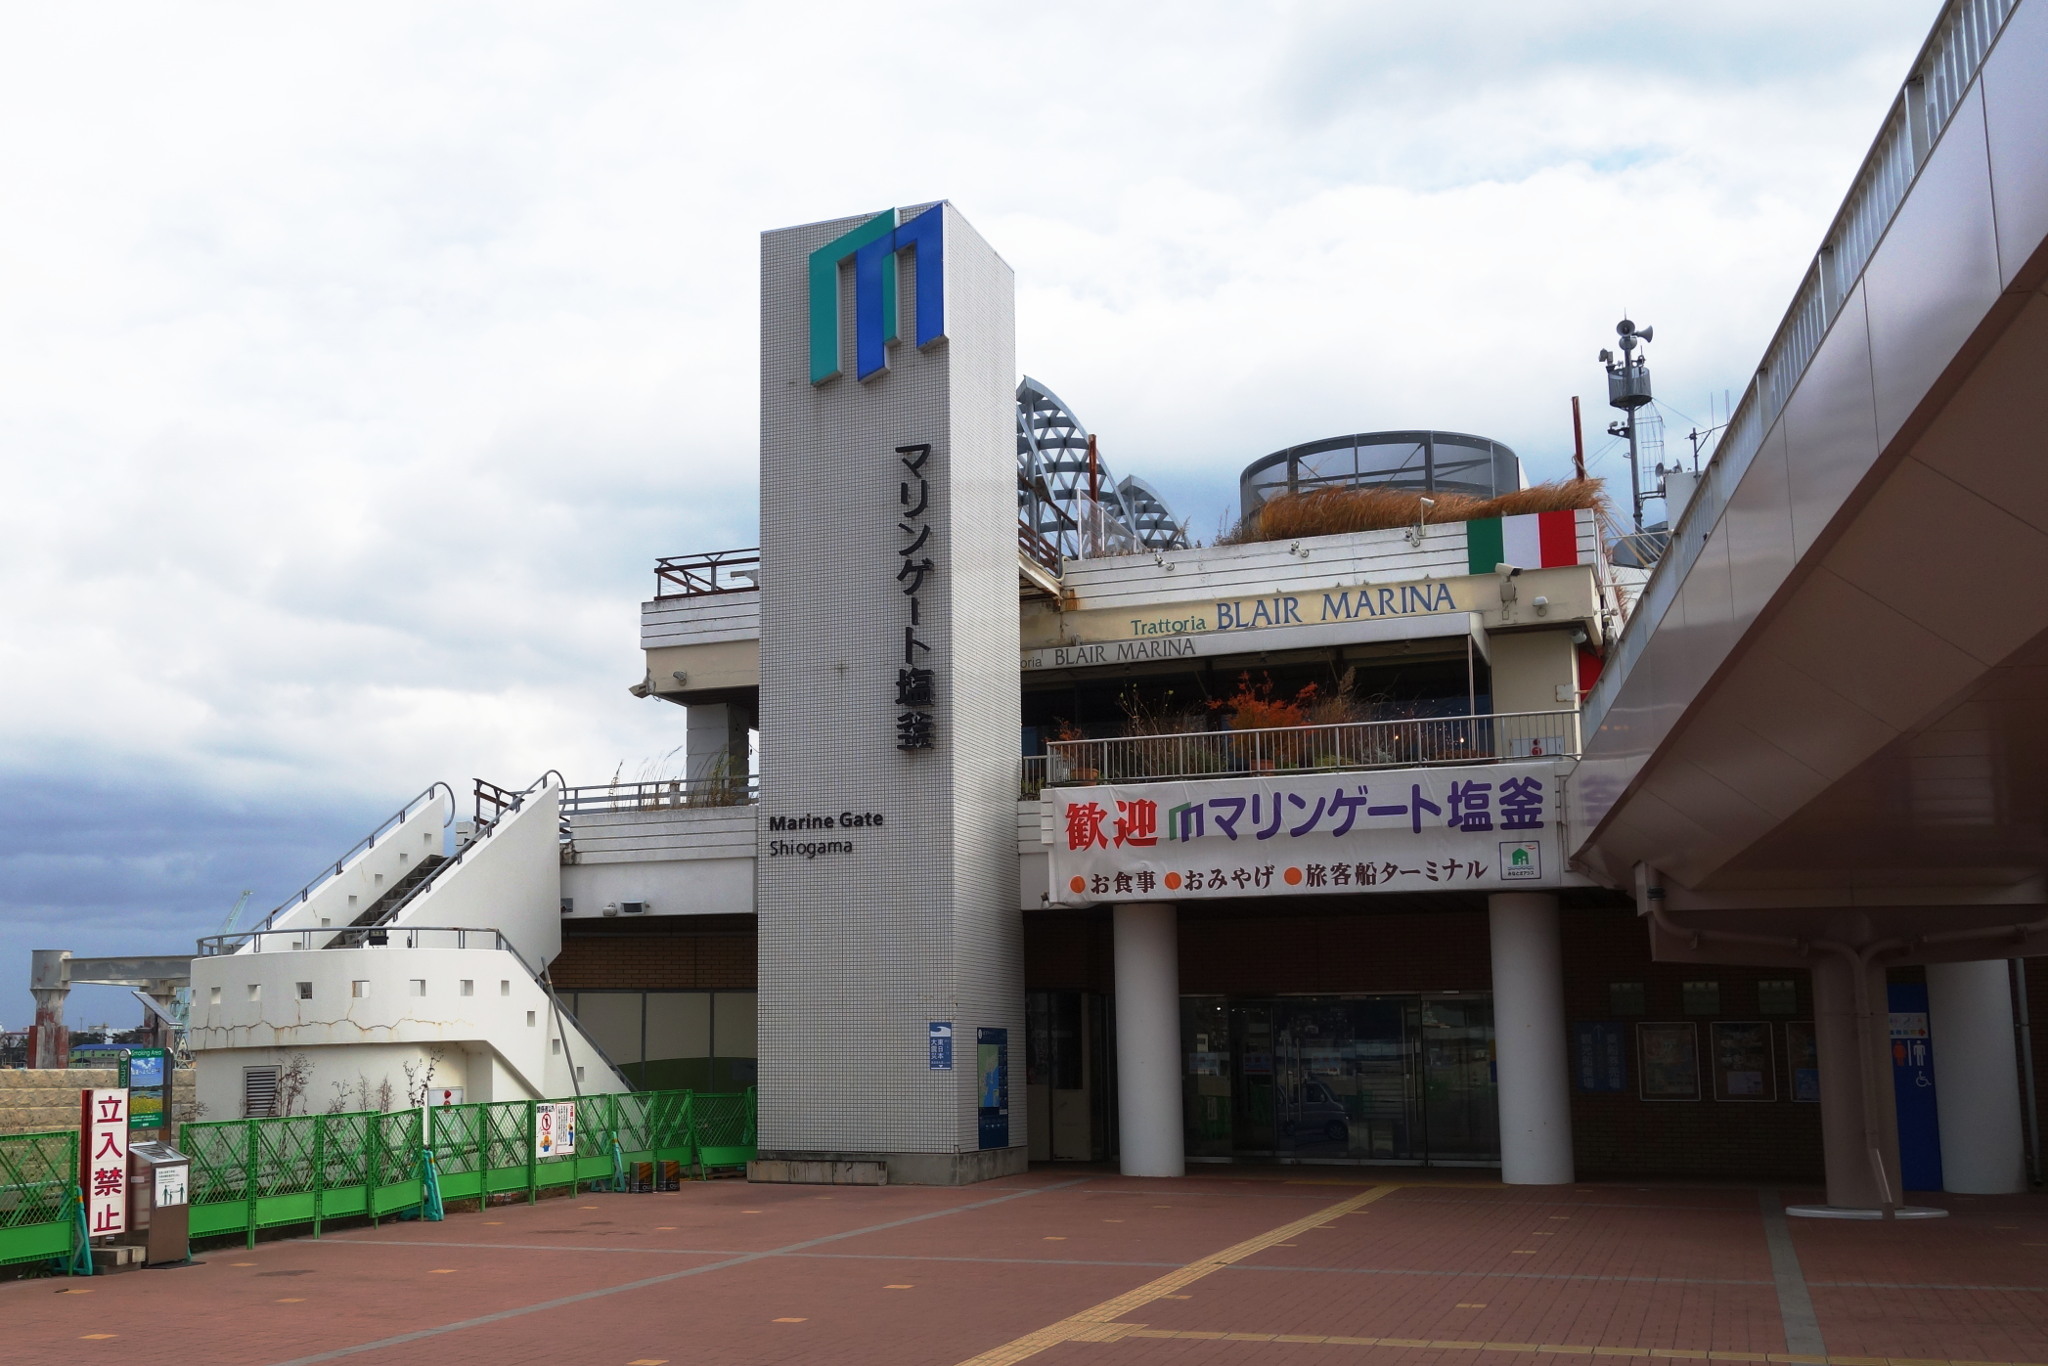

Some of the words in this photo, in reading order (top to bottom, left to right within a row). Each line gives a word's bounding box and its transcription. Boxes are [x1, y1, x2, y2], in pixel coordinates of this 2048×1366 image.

[895, 443, 935, 751] マリンゲート塩釜
[1130, 615, 1207, 636] Trattoria
[1216, 596, 1303, 631] BLAIR
[1321, 583, 1457, 622] MARINA
[1054, 645, 1108, 667] BLAIR
[1116, 638, 1197, 661] MARINA
[769, 813, 834, 831] Marine
[839, 812, 884, 828] Gate
[1065, 798, 1159, 851] 歓迎
[1208, 776, 1545, 841] マリンゲート塩釜
[769, 839, 853, 859] Shiogama
[1090, 870, 1157, 895] お食事
[1184, 864, 1276, 891] おみやげ
[1305, 857, 1489, 888] 旅客船ターミナル
[93, 1096, 123, 1232] 立入禁止
